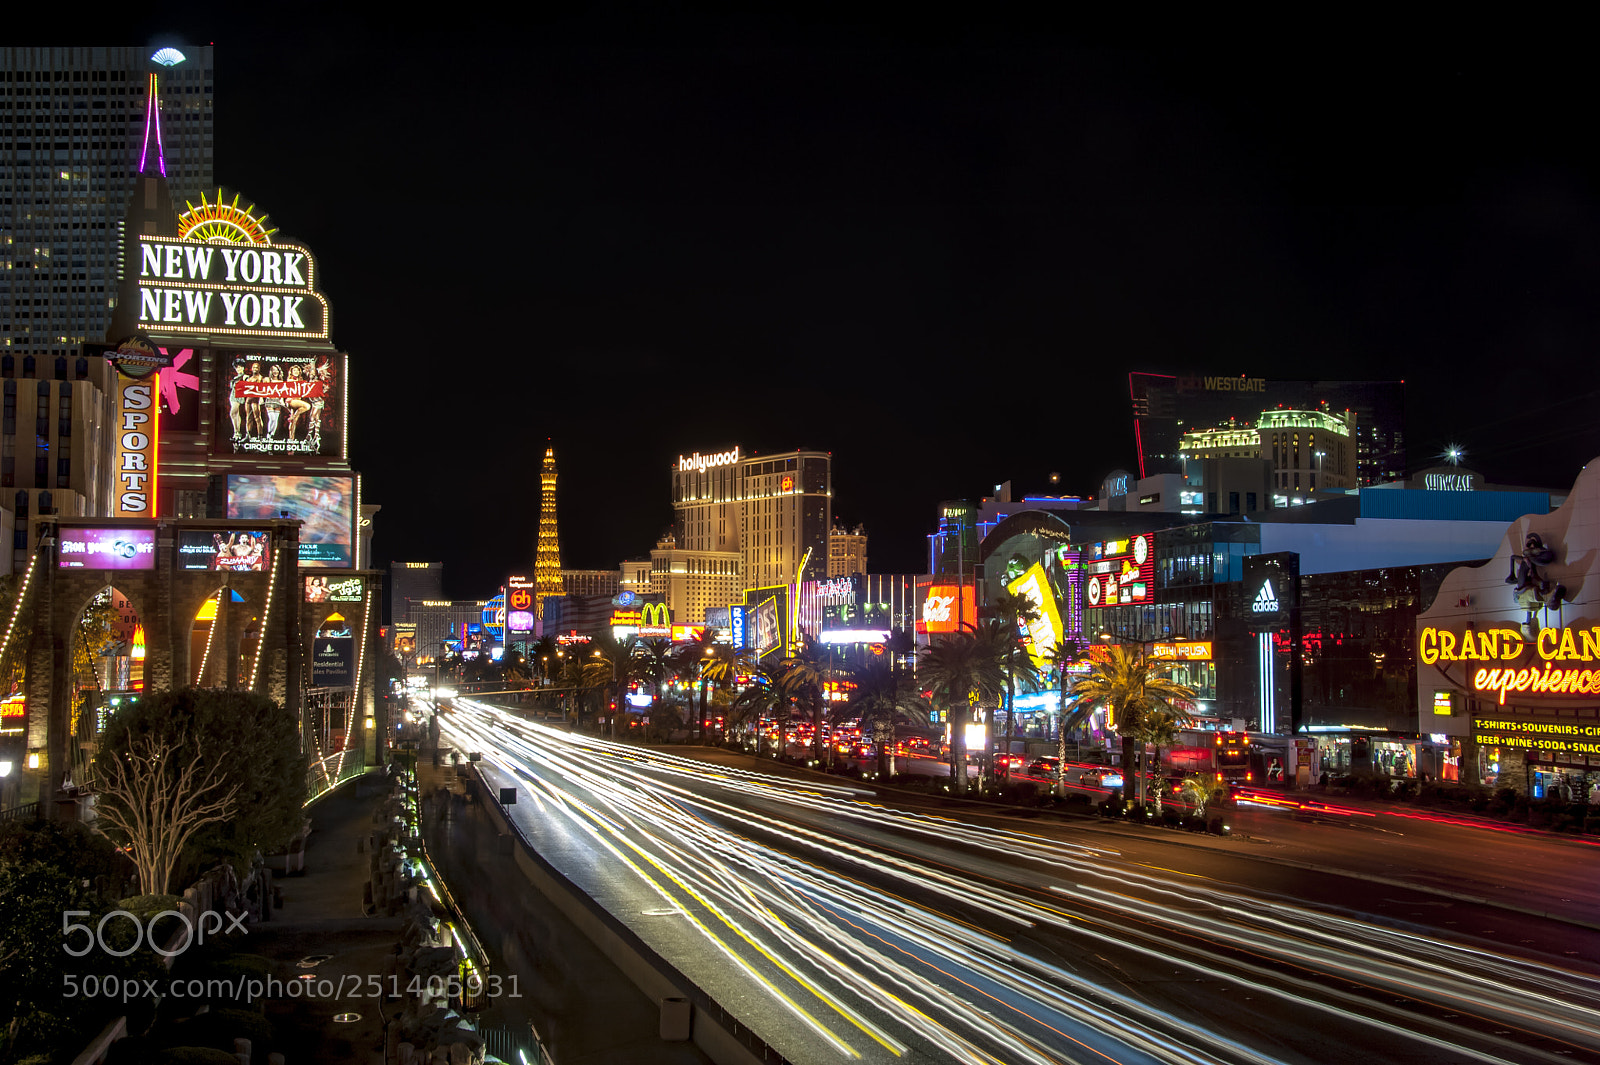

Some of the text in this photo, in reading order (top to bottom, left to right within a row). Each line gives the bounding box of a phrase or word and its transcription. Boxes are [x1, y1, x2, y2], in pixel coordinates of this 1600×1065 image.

[140, 243, 306, 285] NEW YORK
[139, 287, 305, 329] NEW YORK
[243, 382, 316, 398] ZUMANITY
[1204, 376, 1266, 392] WESTGATE
[121, 385, 152, 512] SPORTS
[243, 443, 272, 452] CIRQUE
[286, 444, 314, 452] SOLEIL
[679, 446, 739, 473] hollywood
[1425, 473, 1474, 491] SHOWCASE
[513, 590, 530, 607] ph
[1252, 599, 1279, 613] adidas
[733, 607, 743, 648] ROSS
[1420, 626, 1600, 665] GRAND CAN
[1474, 661, 1600, 705] experience
[1475, 719, 1517, 731] T-SHIRTS
[1522, 722, 1579, 735] SOUVENIRS
[1476, 735, 1500, 745] BEER
[1505, 737, 1533, 748] WINE
[1538, 740, 1567, 751] SODA
